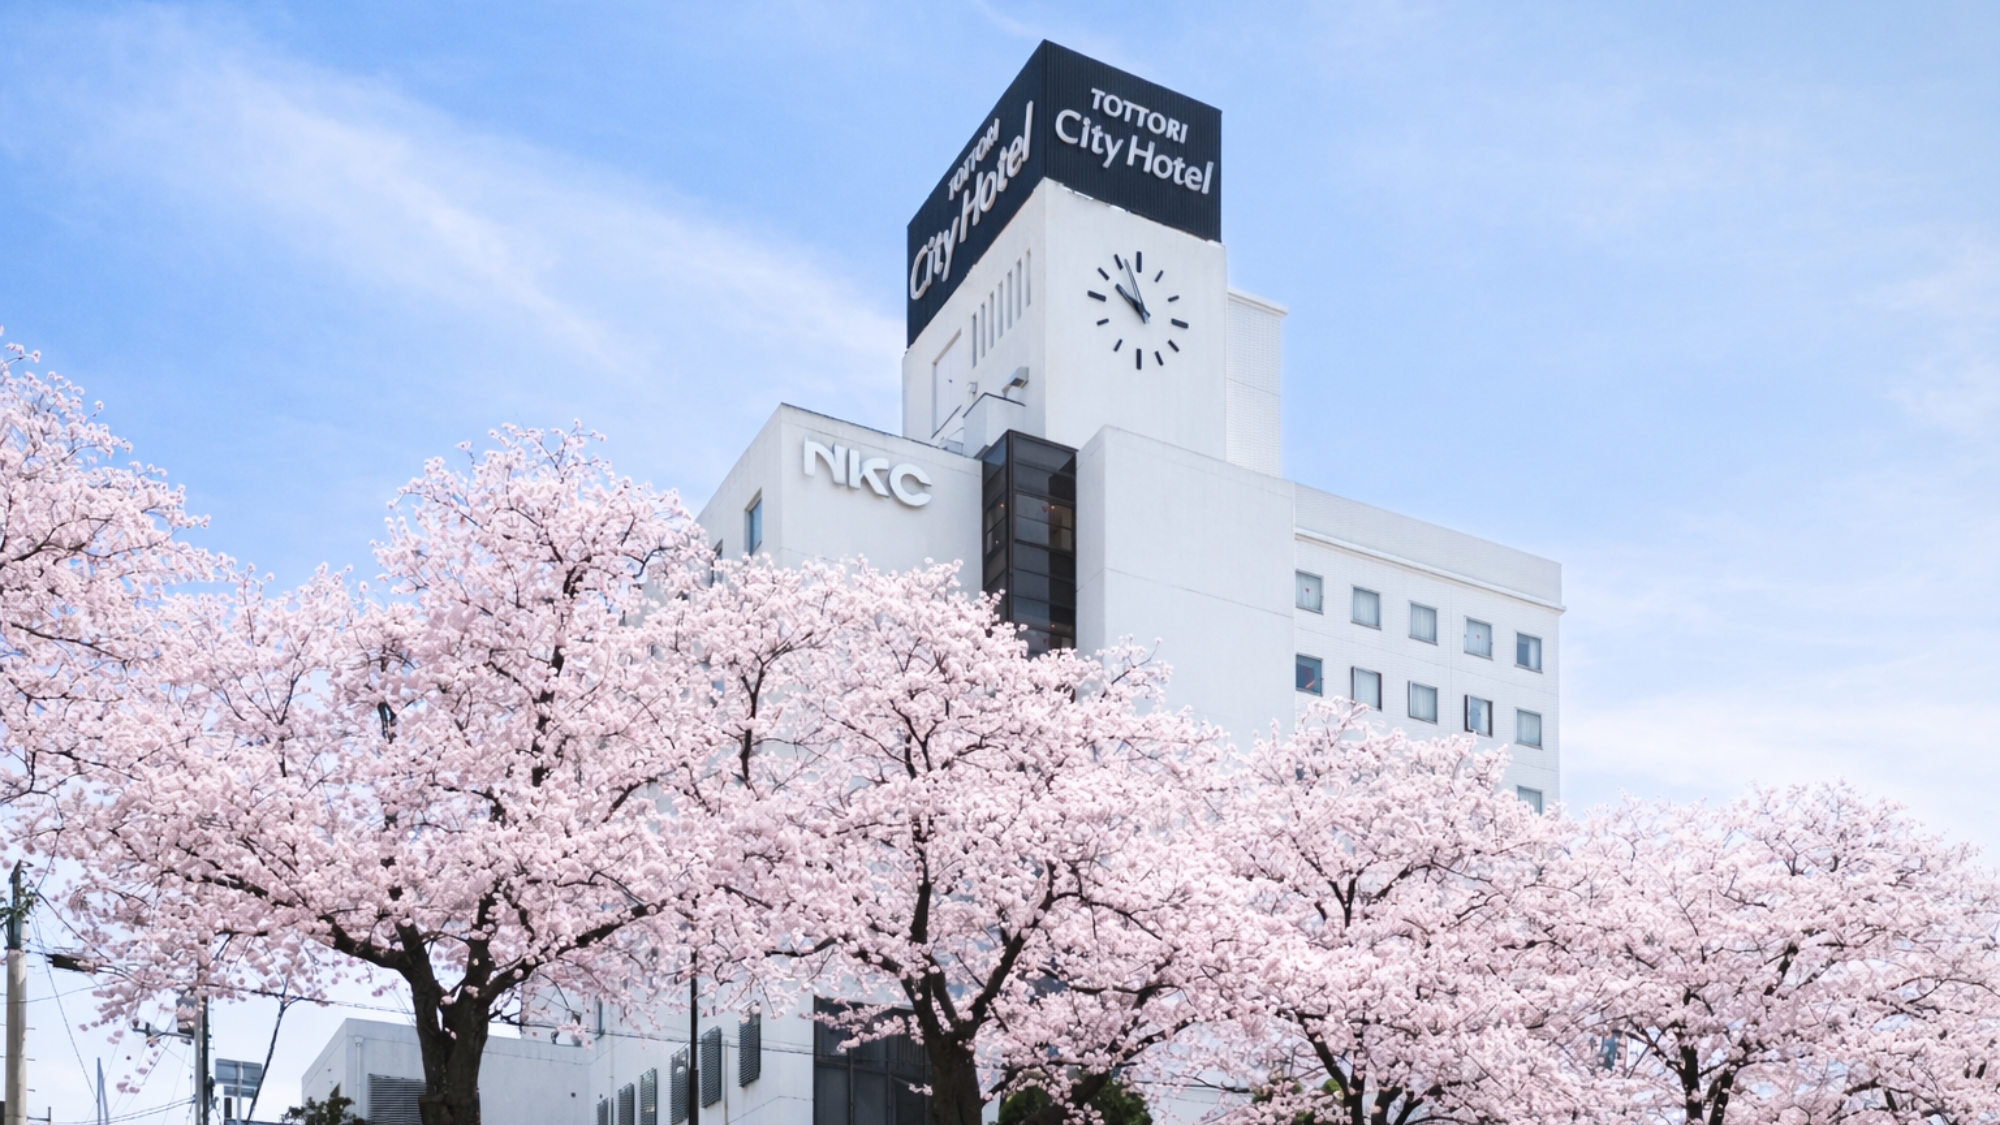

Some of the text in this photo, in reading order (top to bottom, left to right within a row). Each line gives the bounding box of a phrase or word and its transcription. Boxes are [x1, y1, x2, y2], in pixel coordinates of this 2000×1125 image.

[1055, 109, 1214, 194] City Hotel
[1091, 87, 1188, 144] TOTTORI
[910, 100, 1034, 300] City Hotel
[948, 117, 1000, 200] TOTTORI
[804, 436, 932, 508] NKC
